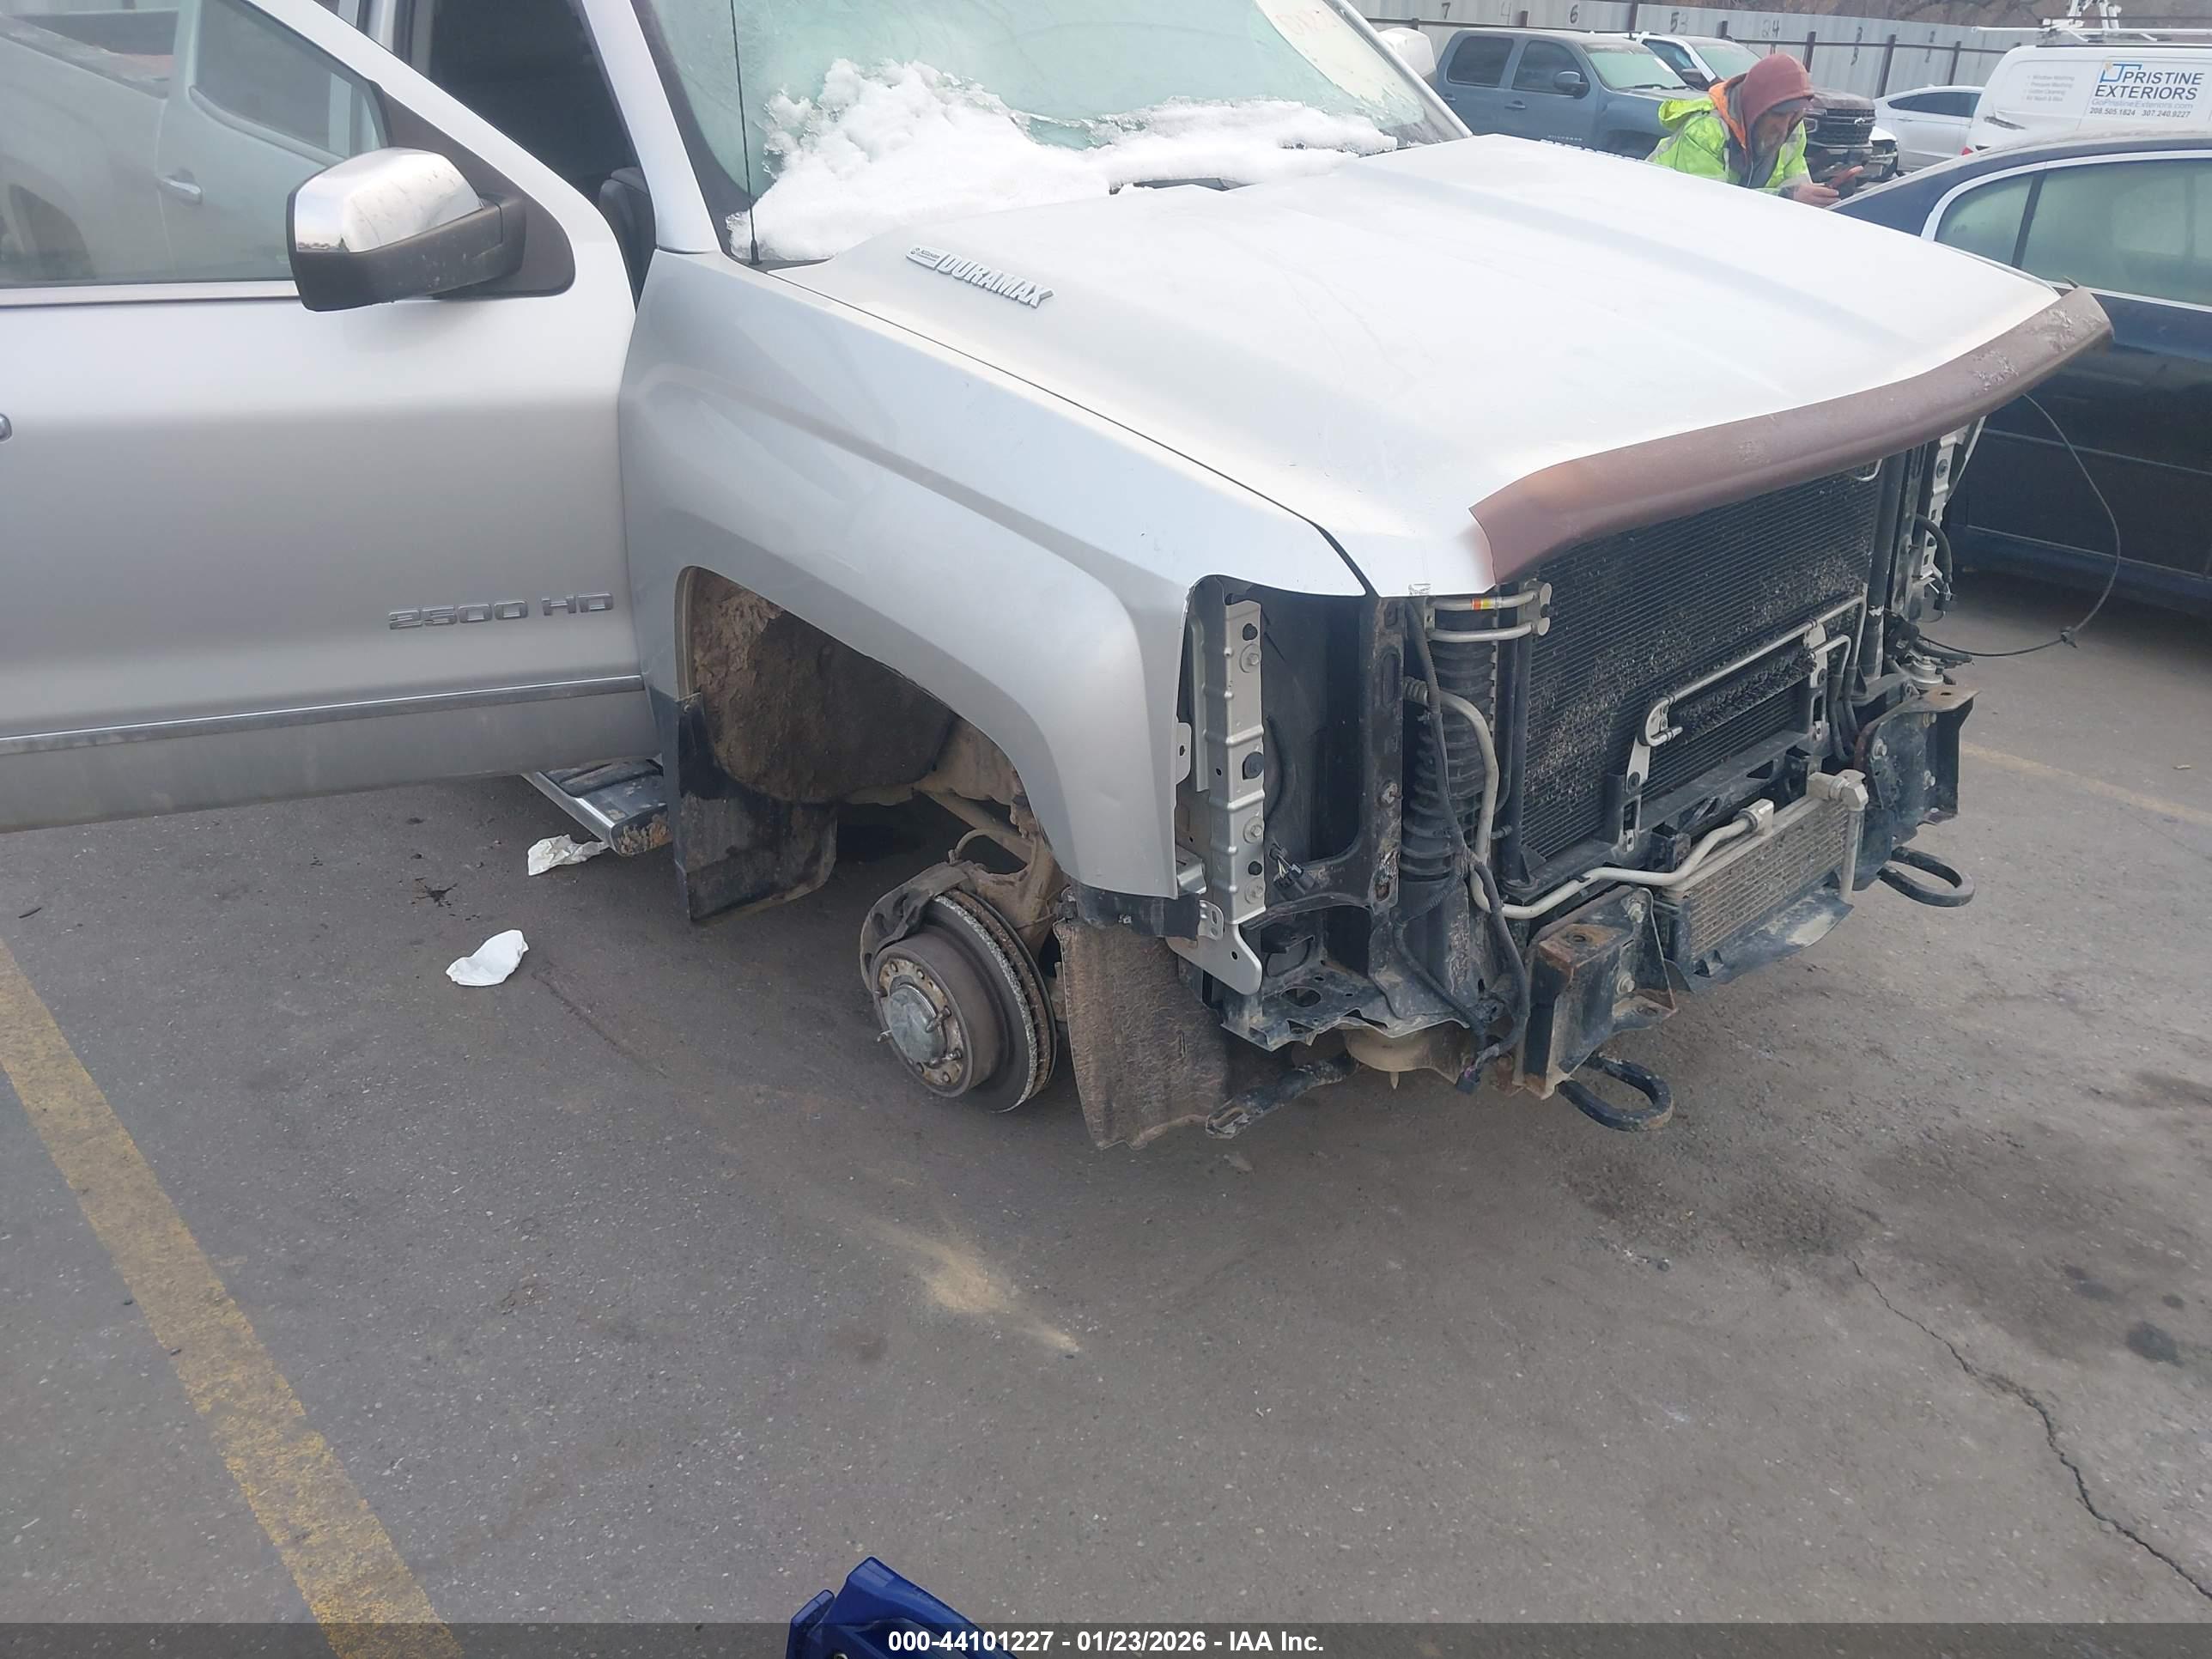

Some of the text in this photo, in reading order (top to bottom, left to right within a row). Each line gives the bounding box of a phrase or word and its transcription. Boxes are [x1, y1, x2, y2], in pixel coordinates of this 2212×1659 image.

[1441, 2, 1451, 20] 7
[1569, 4, 1579, 24] 6
[2123, 71, 2205, 85] PRISTINE
[2095, 84, 2198, 100] EXTERIORS
[936, 253, 1055, 309] DURAMAX
[388, 592, 614, 630] 2500 HD
